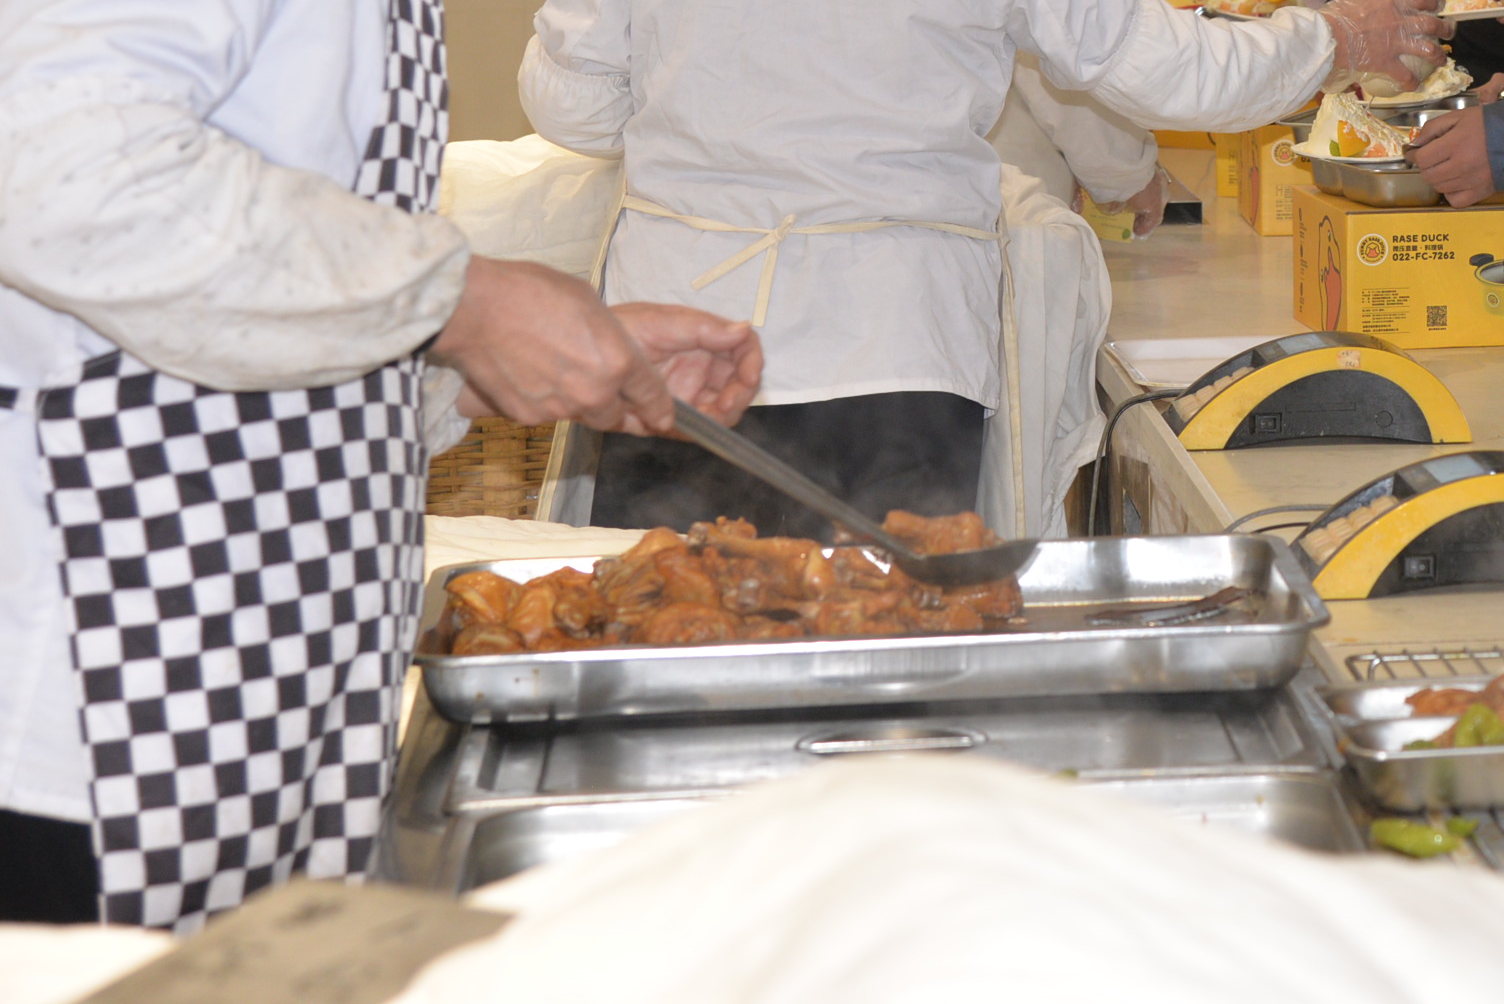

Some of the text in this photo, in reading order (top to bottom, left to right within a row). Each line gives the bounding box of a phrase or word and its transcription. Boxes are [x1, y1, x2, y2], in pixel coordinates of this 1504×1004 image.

[1392, 233, 1449, 243] RASE DUCK
[1392, 251, 1455, 261] 022-FC-7262
